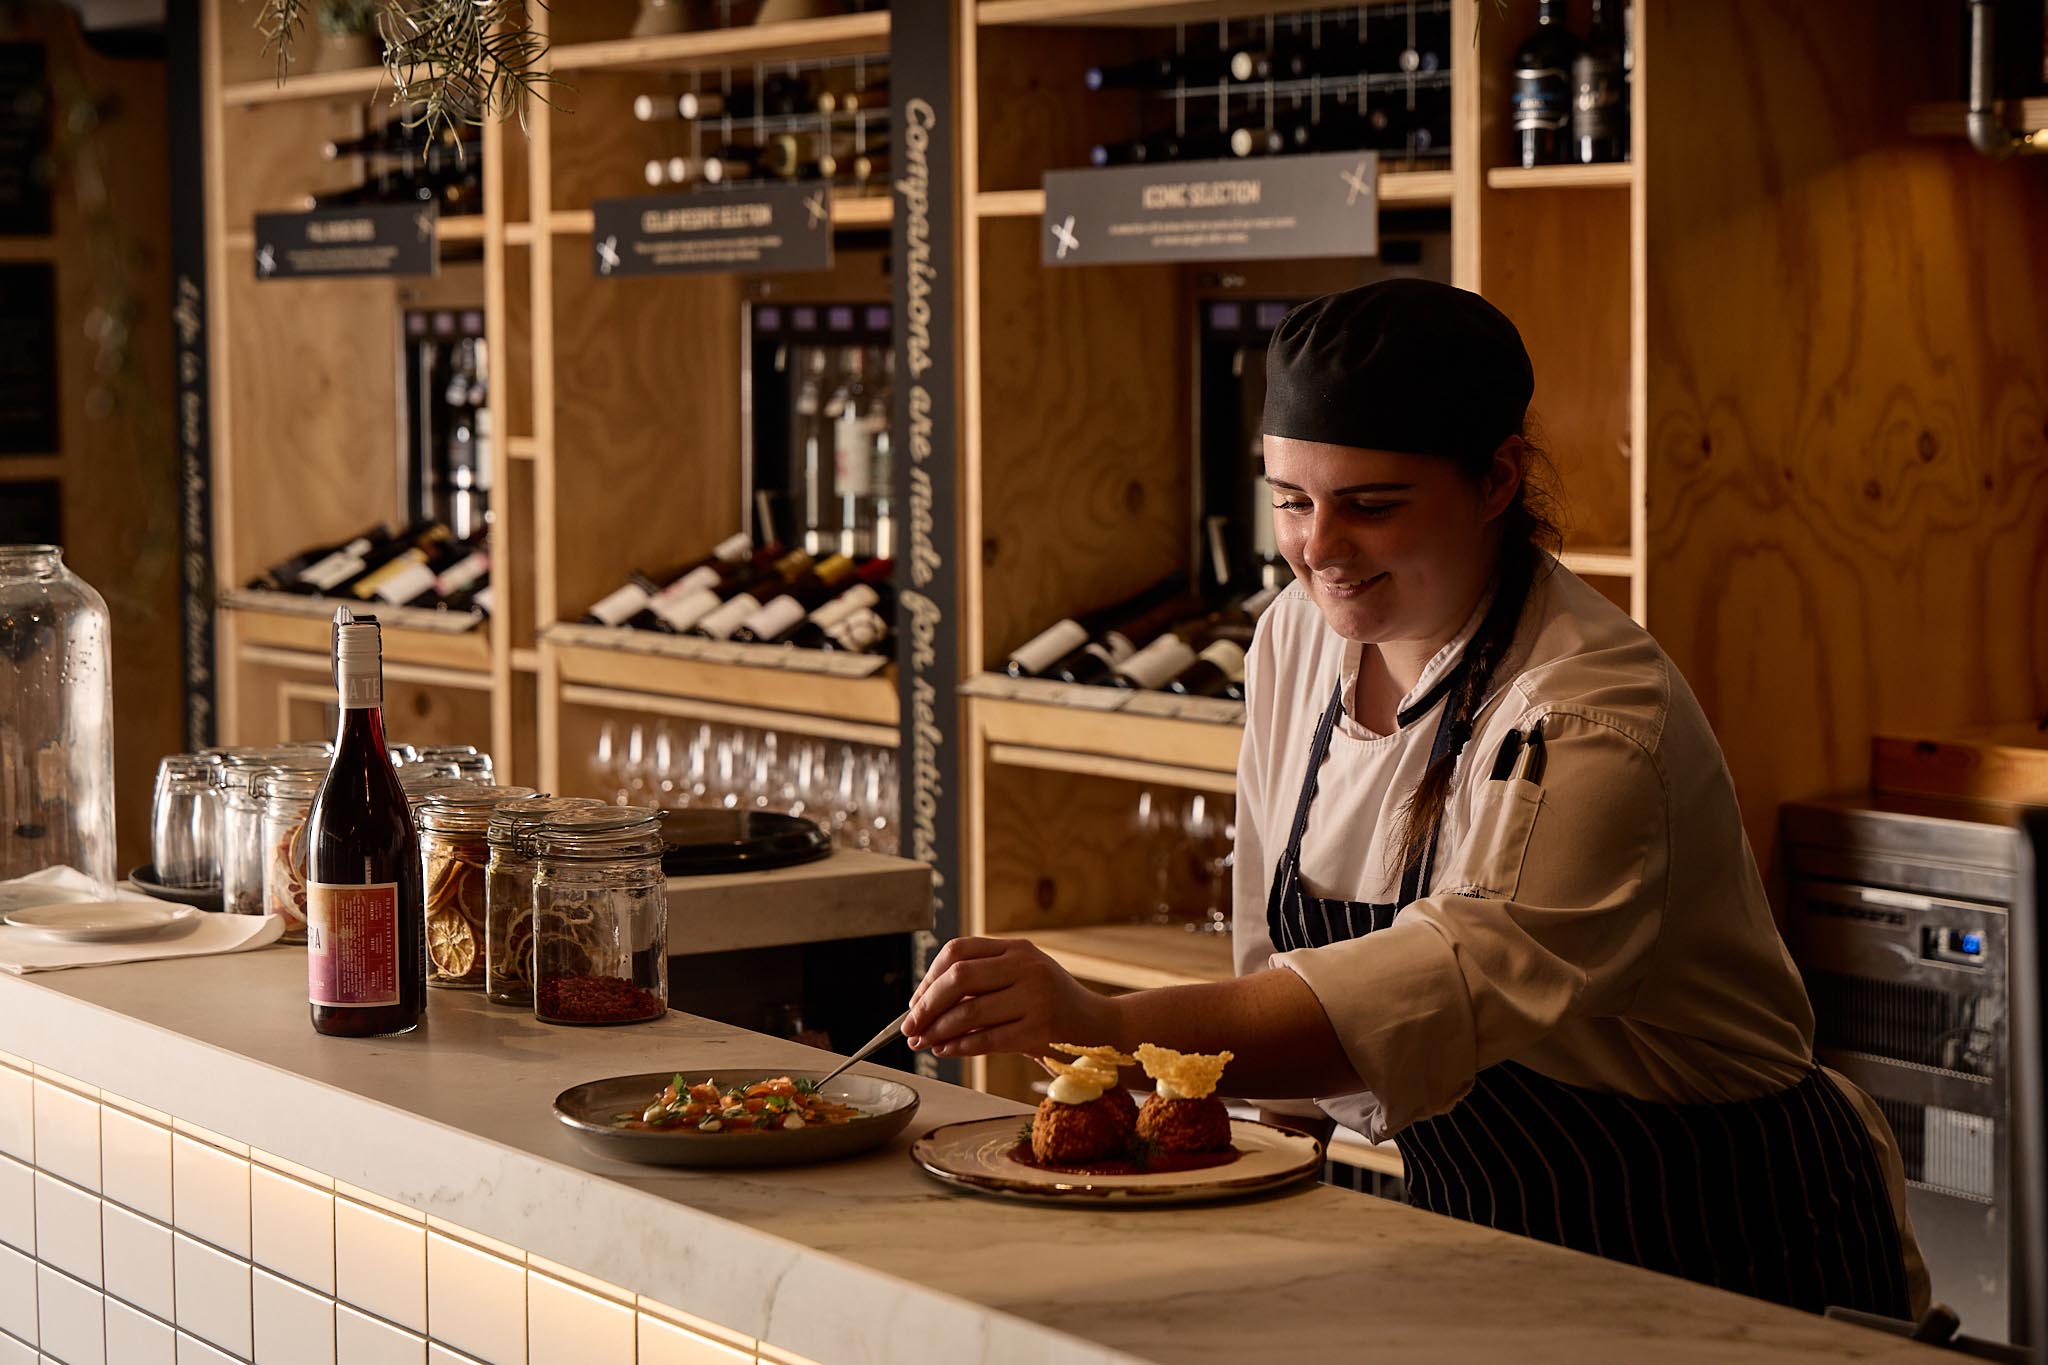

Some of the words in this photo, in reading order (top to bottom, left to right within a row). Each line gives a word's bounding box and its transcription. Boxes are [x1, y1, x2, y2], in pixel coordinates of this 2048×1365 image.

[1188, 180, 1262, 208] SELECTION
[895, 98, 937, 377] Comparisons
[909, 383, 932, 461] are
[909, 466, 941, 584] made
[900, 589, 942, 667] for
